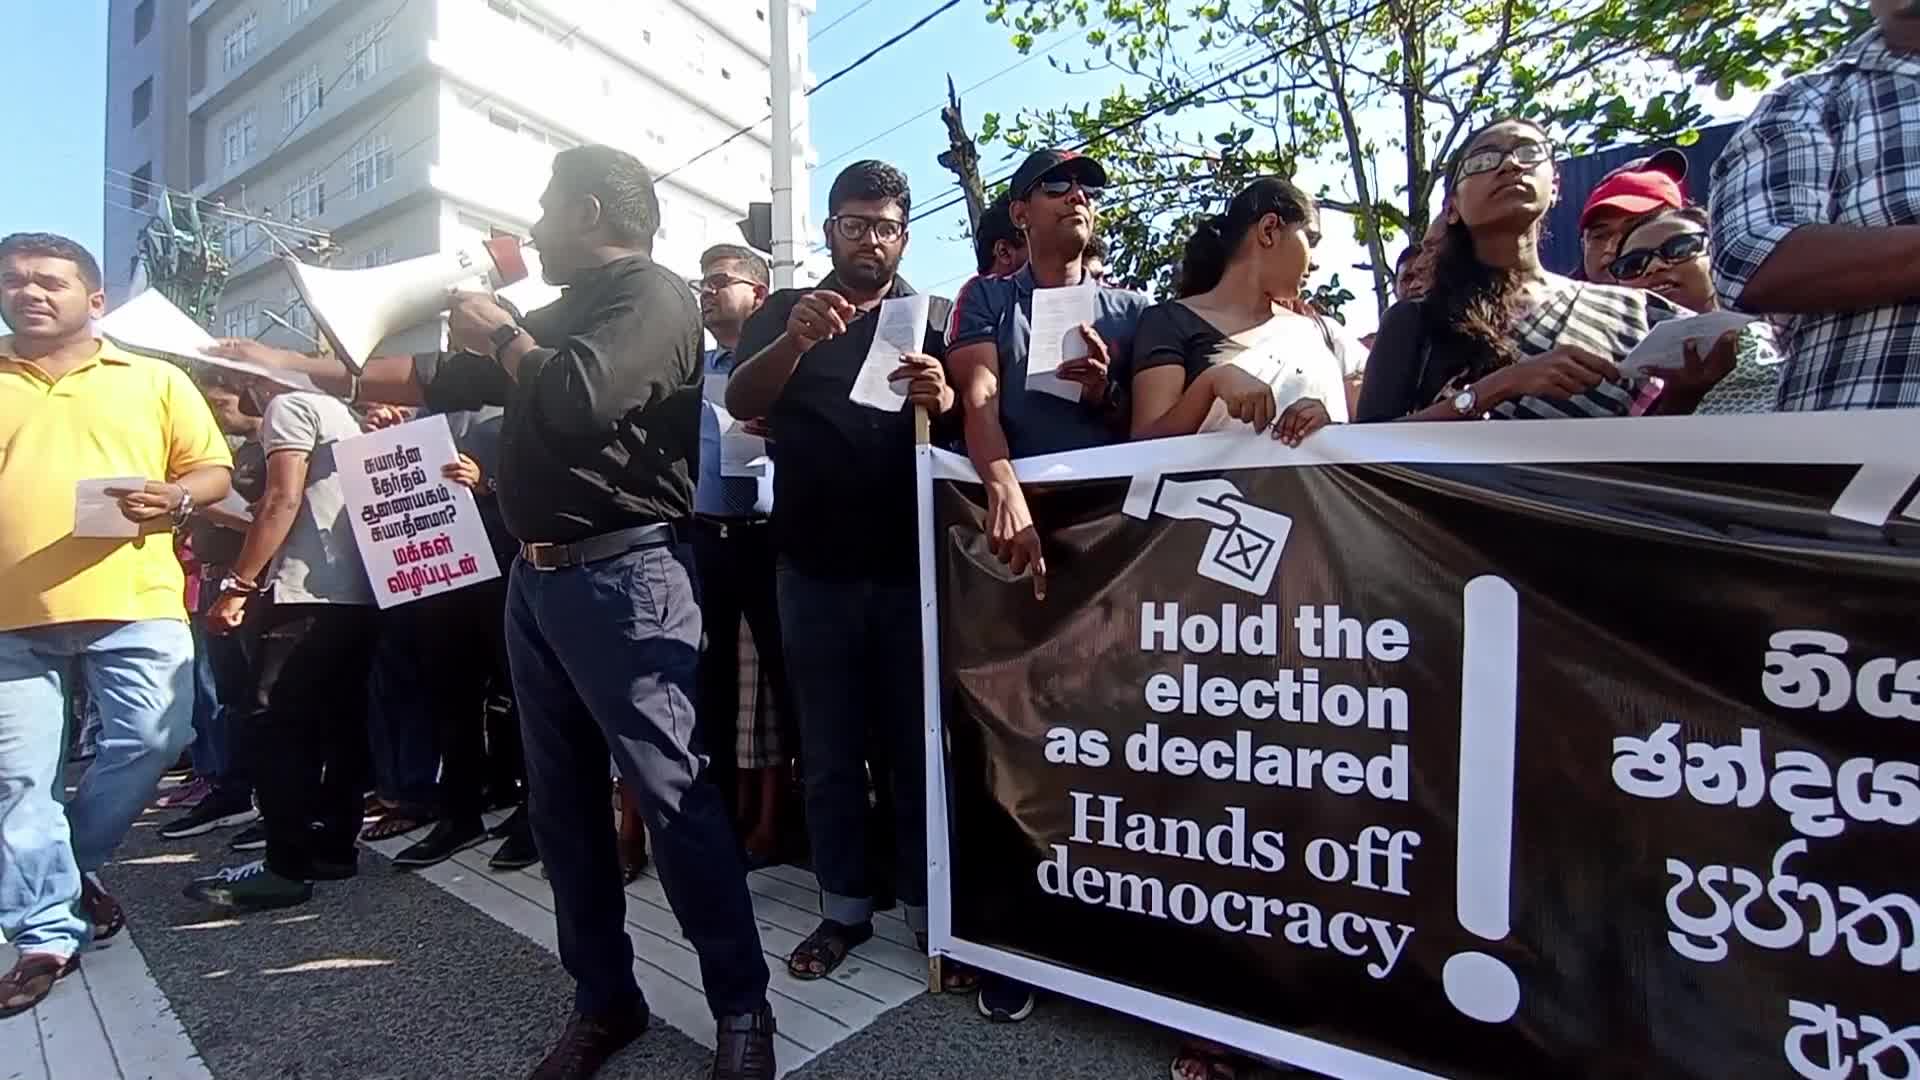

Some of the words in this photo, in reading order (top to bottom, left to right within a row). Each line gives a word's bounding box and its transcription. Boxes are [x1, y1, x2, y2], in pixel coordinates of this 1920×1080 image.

[364, 444, 422, 474] சுயாதீன
[372, 466, 427, 497] தேர்தல்
[371, 505, 457, 543] சுயாதீனமா?
[393, 532, 453, 567] மக்கள்
[387, 553, 478, 596] விழிப்புடன்
[1140, 602, 1277, 655] Hold
[1294, 605, 1410, 661] the
[1145, 664, 1409, 731] election
[1044, 727, 1110, 767] as
[1125, 723, 1409, 801] declared
[1069, 792, 1285, 872] Hands
[1304, 826, 1421, 895] off
[1036, 844, 1415, 979] democracy
